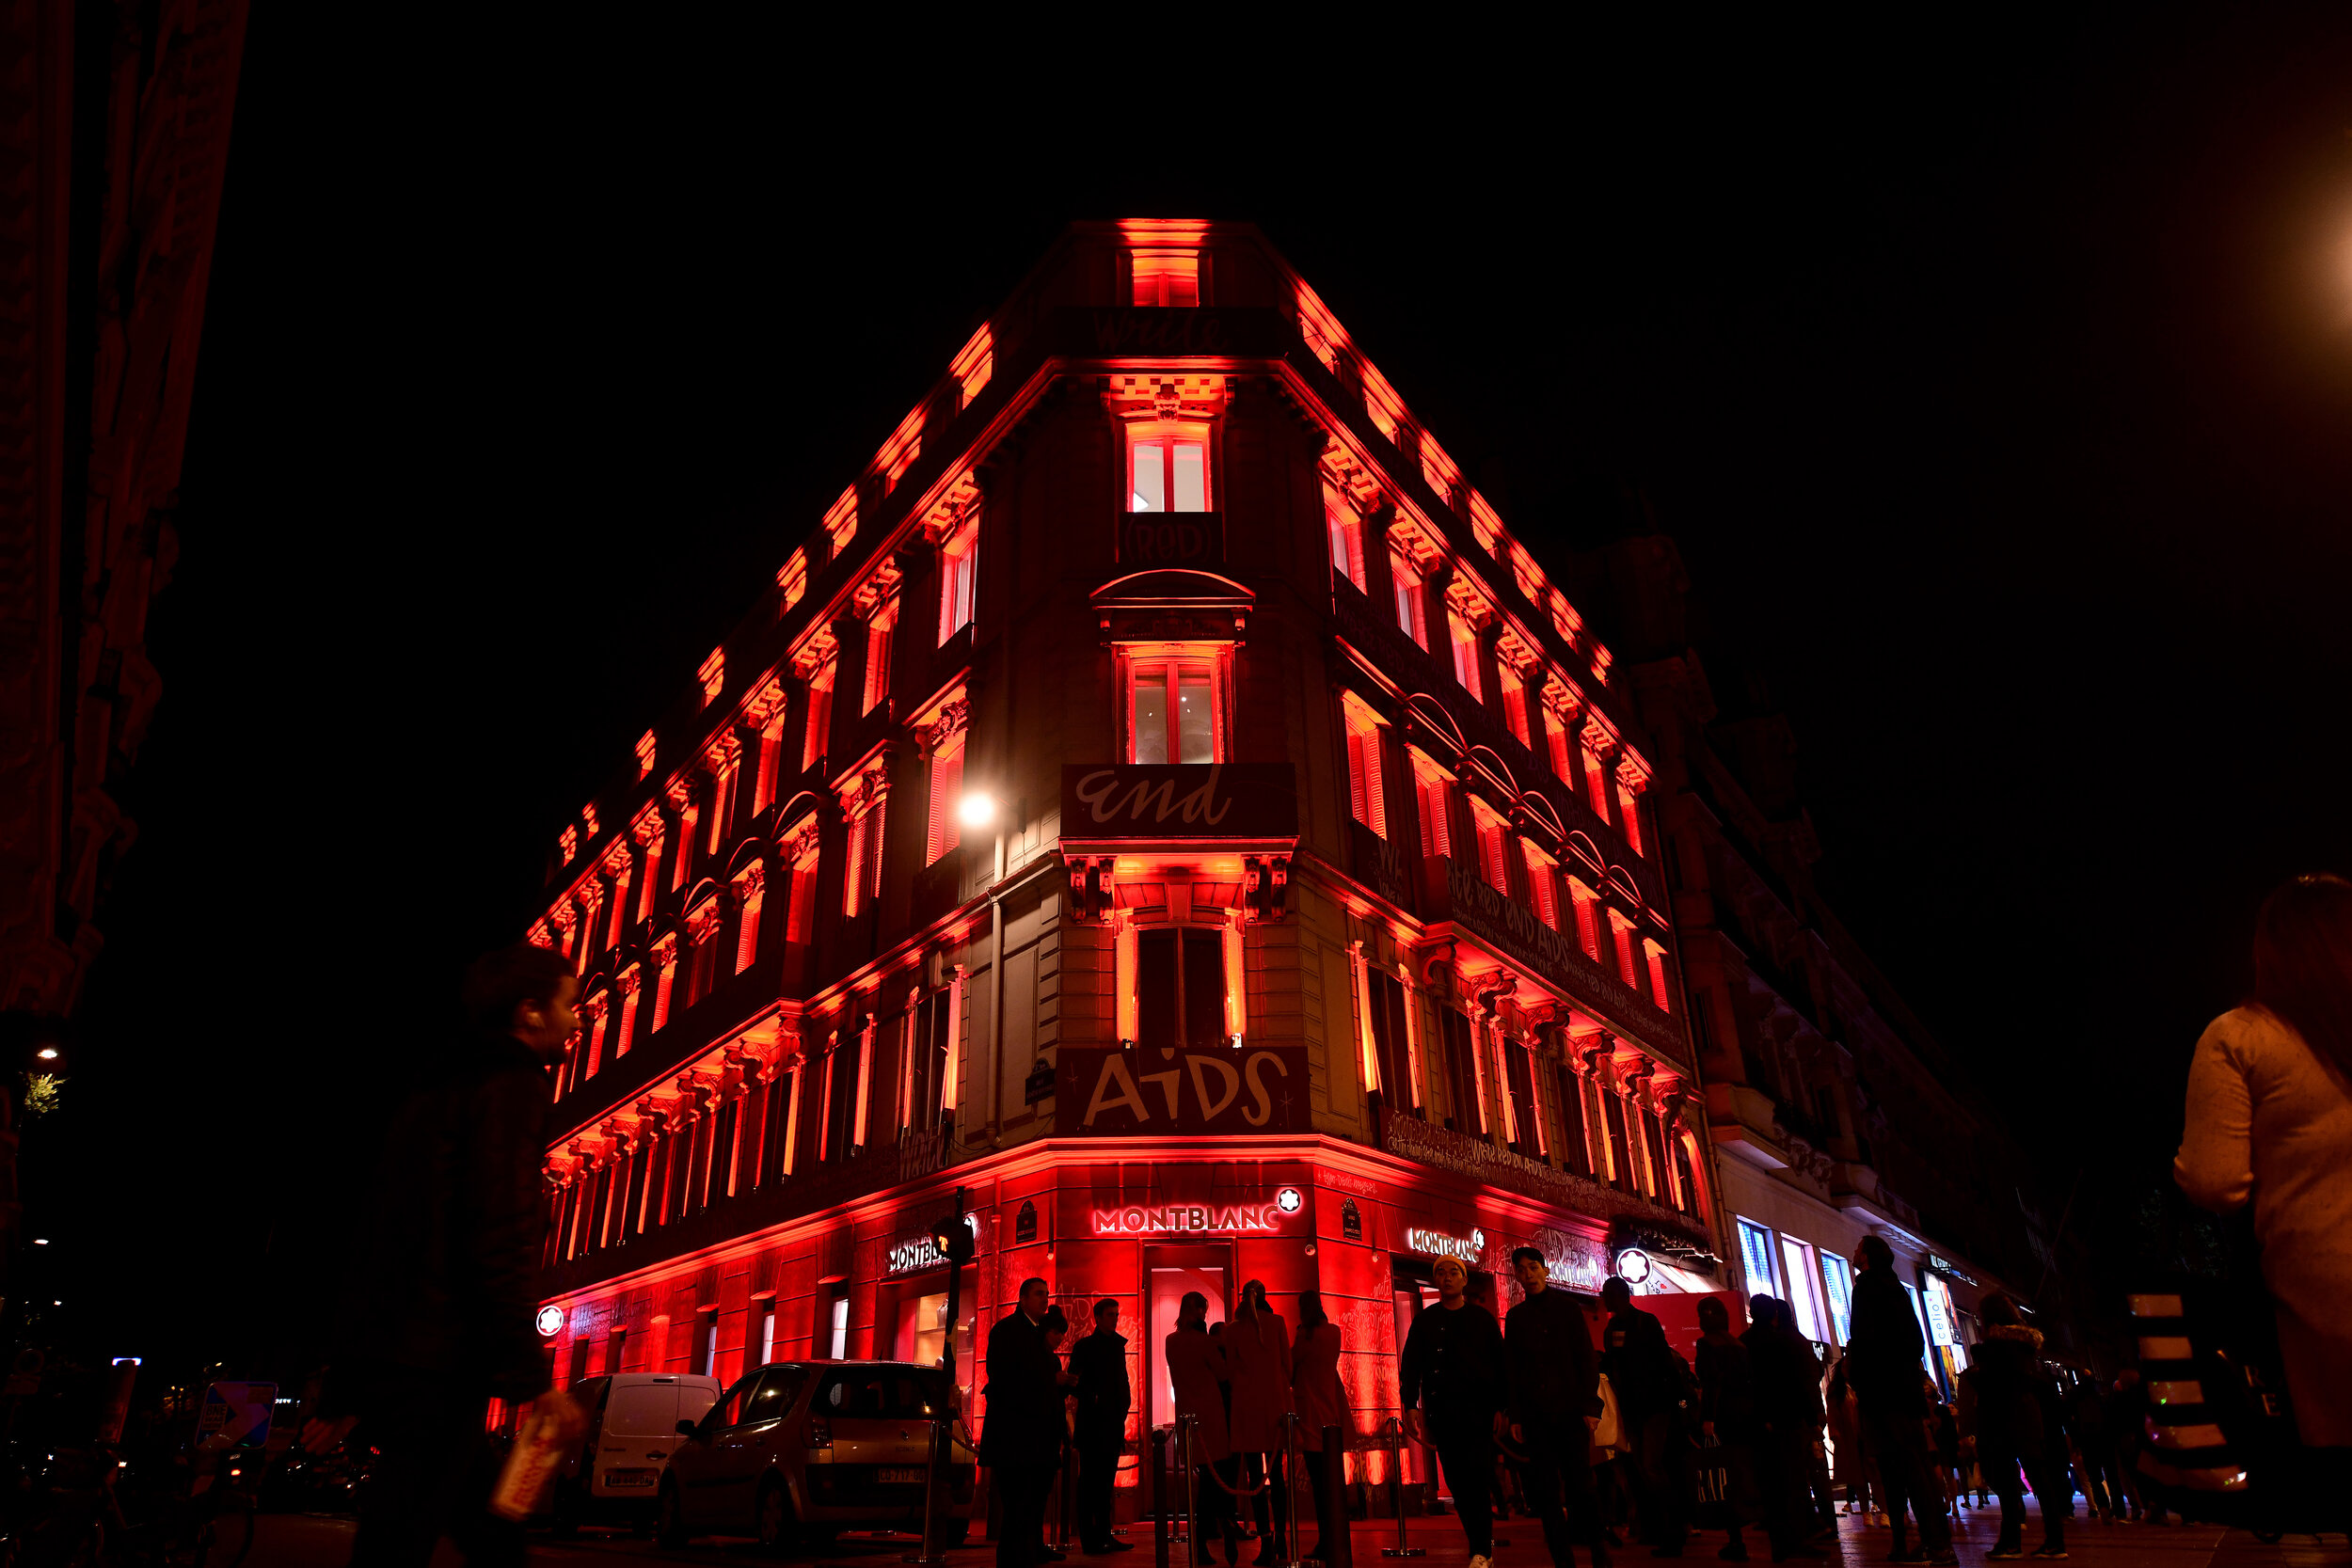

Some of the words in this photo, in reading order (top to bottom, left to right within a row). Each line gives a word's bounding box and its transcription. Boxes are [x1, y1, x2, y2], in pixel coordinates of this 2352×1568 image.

[1095, 1206, 1281, 1234] MONTBLANC
[1409, 1227, 1480, 1263] MONTBLANC
[1696, 1466, 1728, 1504] GAP
